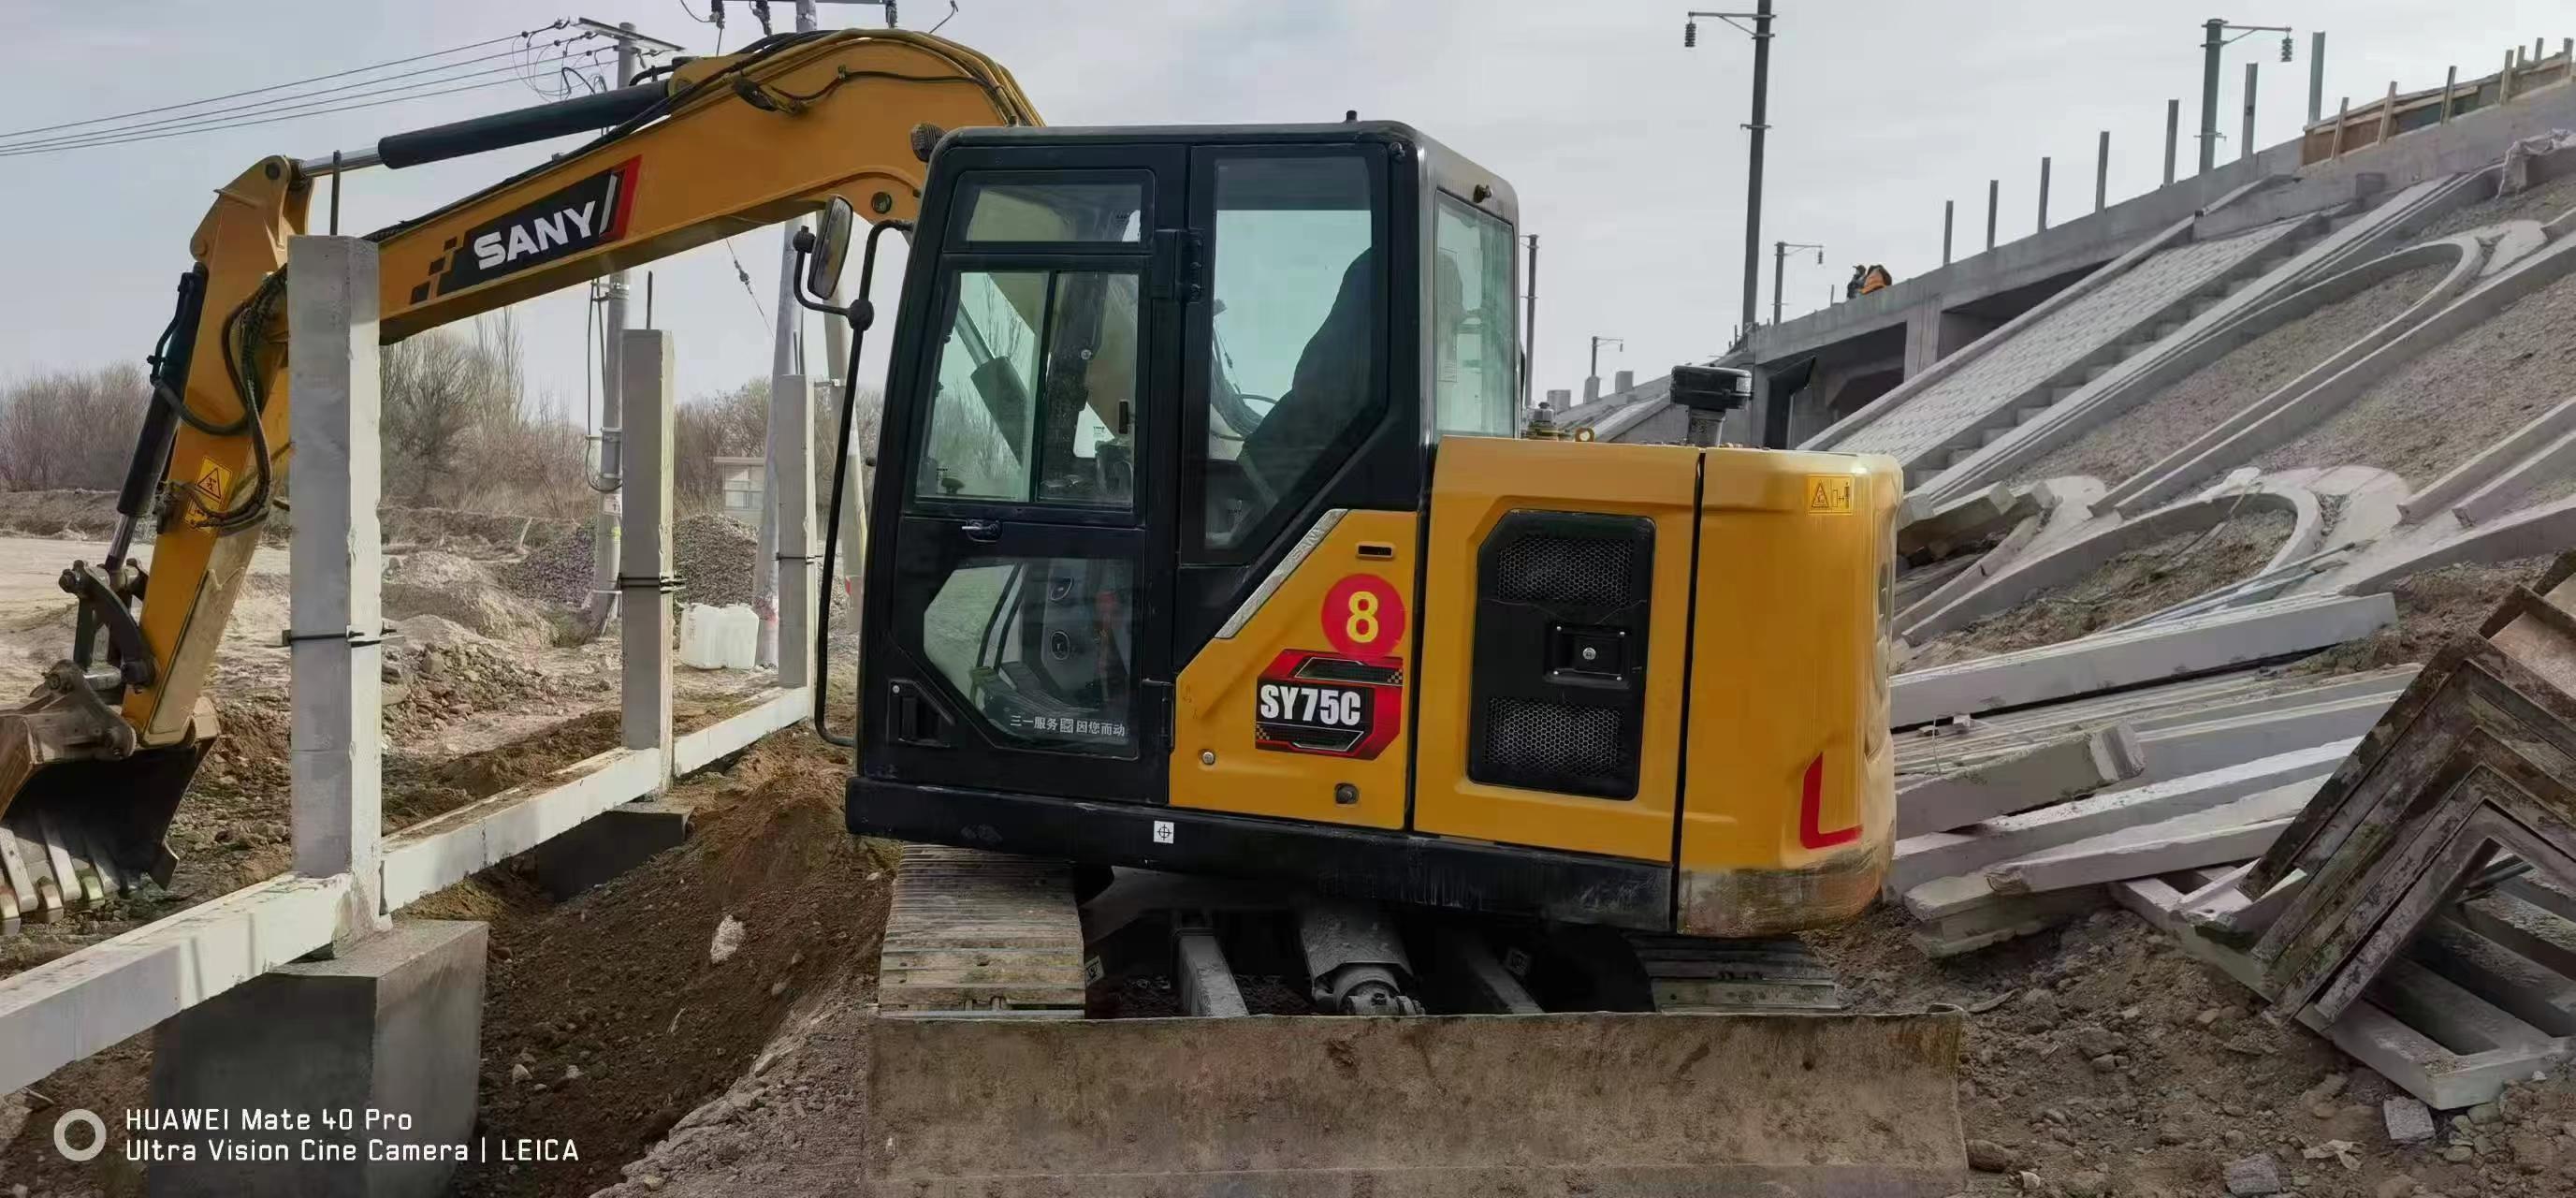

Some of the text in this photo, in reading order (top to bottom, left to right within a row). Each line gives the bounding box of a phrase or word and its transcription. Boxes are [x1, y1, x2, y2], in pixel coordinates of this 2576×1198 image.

[473, 200, 596, 270] SANY
[1346, 591, 1379, 643] 8
[1010, 714, 1126, 737] 三一服务 因您而动
[1260, 684, 1361, 726] SY75C
